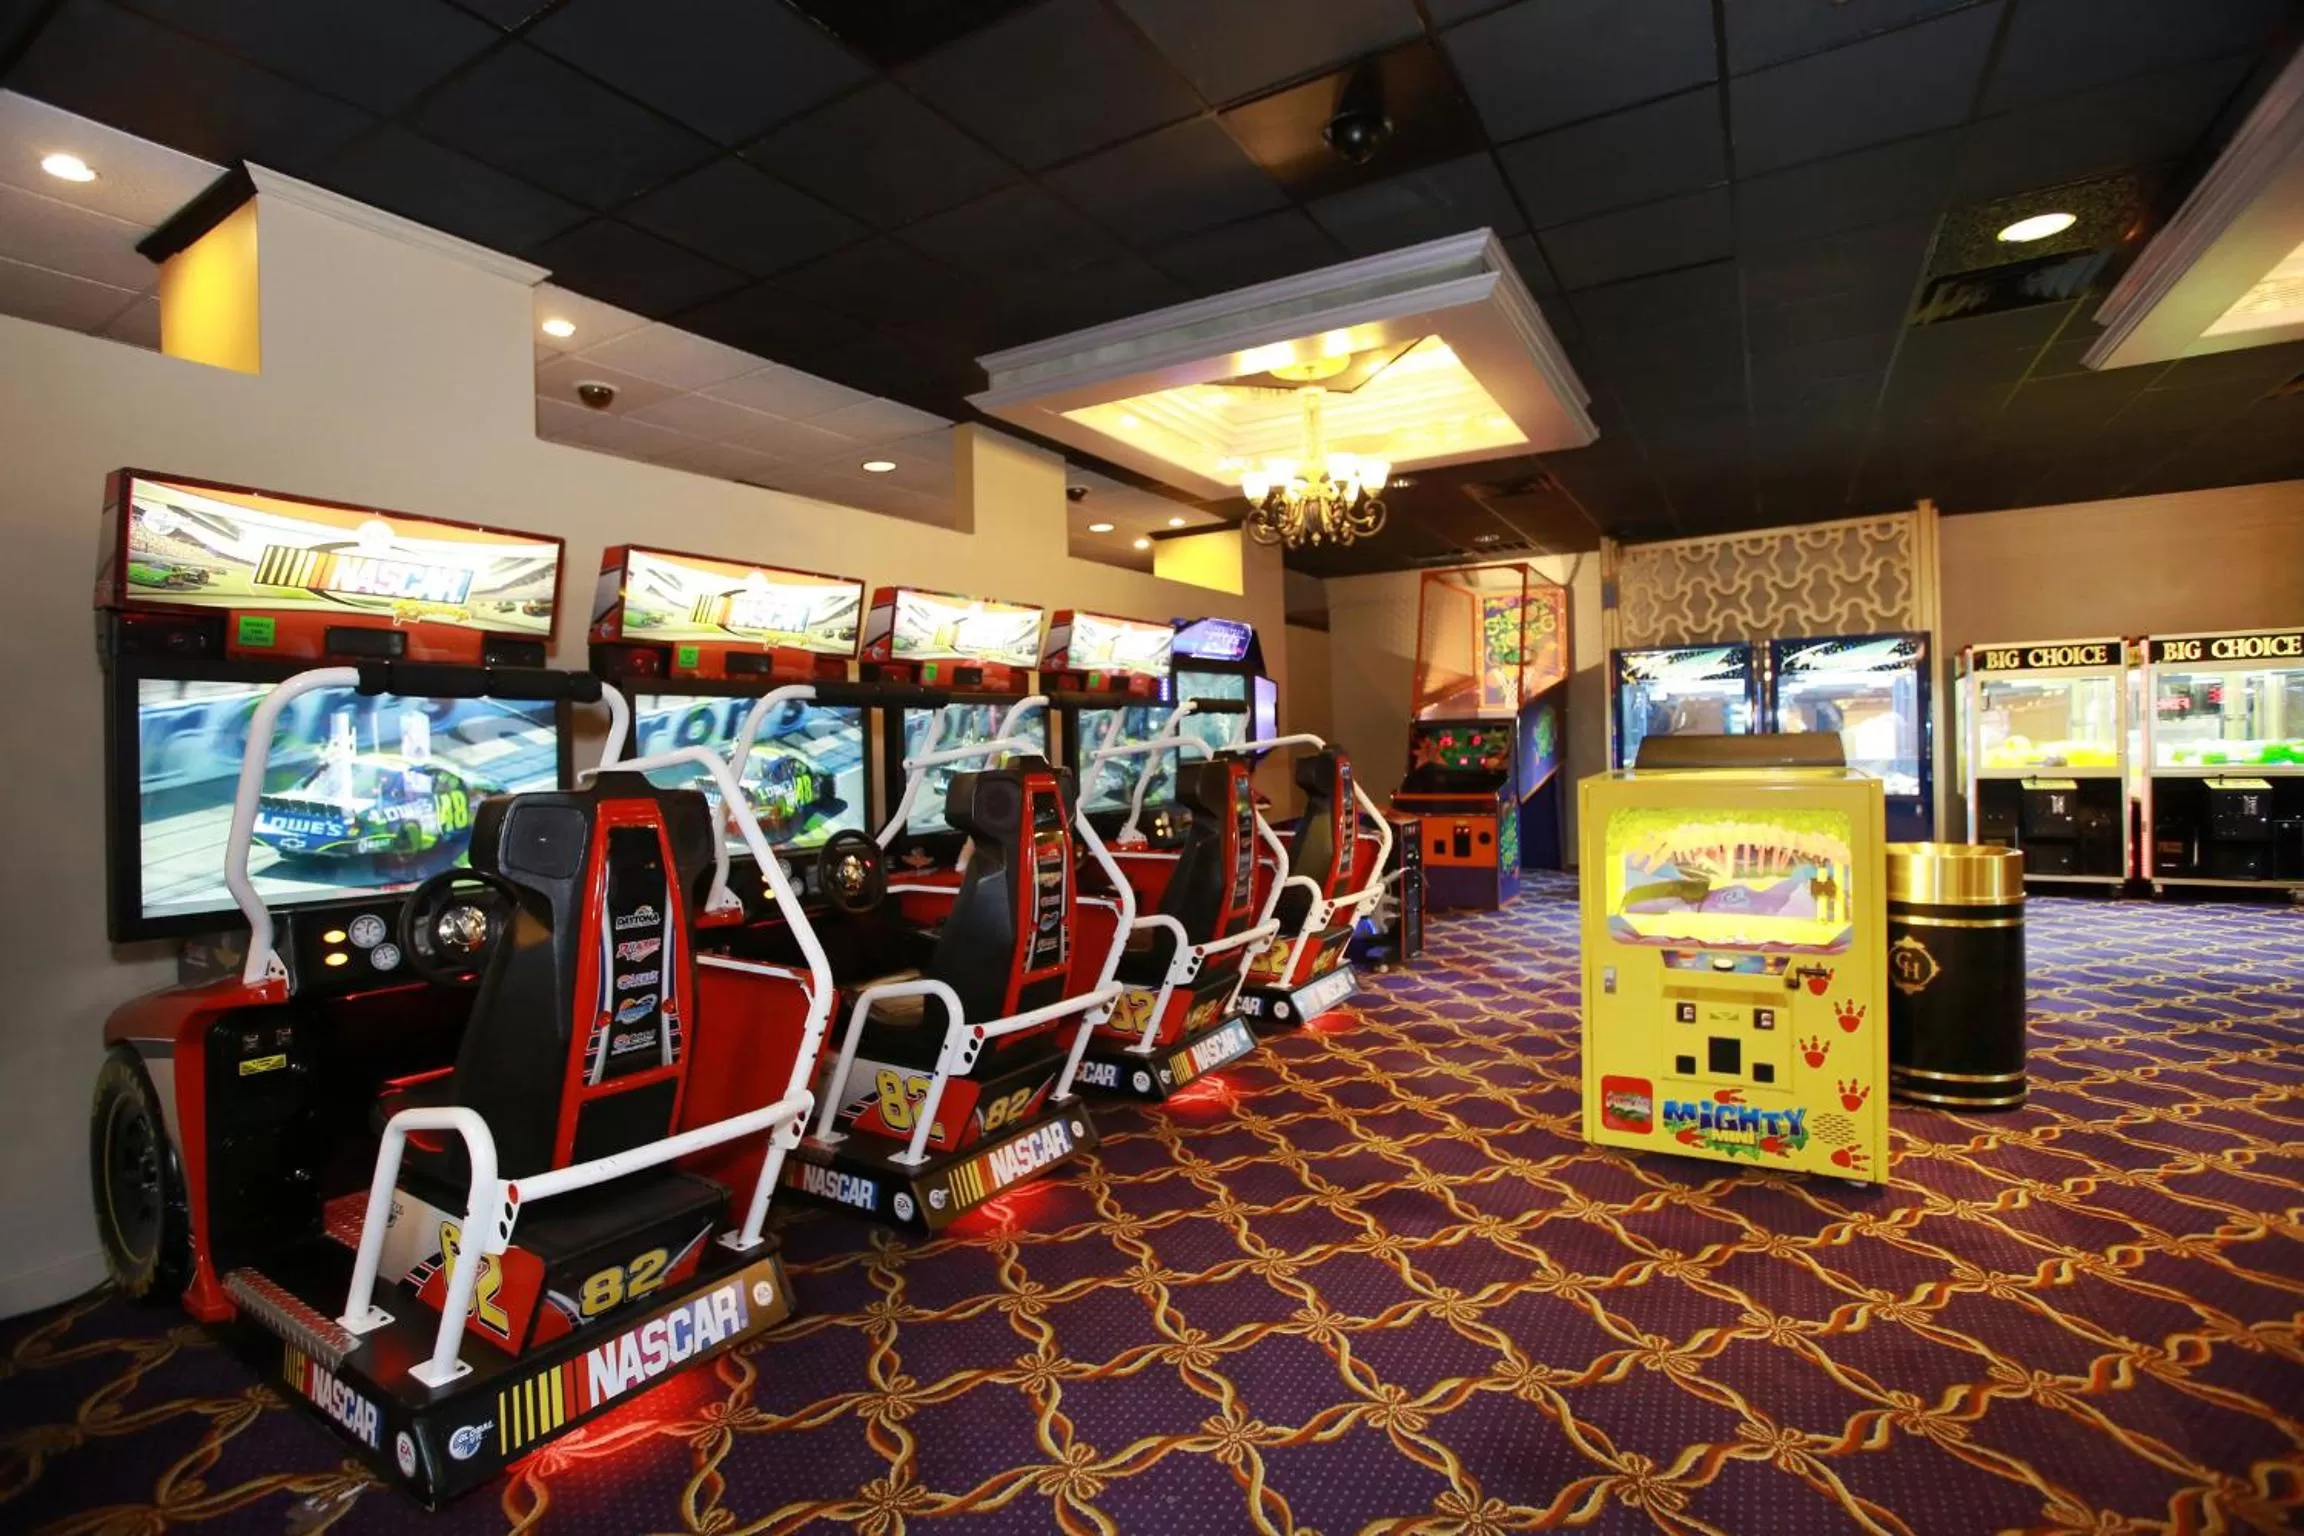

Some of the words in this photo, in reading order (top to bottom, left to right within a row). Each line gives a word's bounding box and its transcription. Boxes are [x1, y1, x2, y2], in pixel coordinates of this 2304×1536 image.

[329, 554, 466, 603] NASCAR
[1986, 650, 2020, 670] BIG
[2028, 644, 2108, 668] CHOICE
[2163, 640, 2202, 663] BIG
[2211, 635, 2303, 660] CHOICE
[254, 811, 345, 838] LOWE'S
[983, 1086, 1033, 1132] 82
[986, 1120, 1073, 1189] NASCAR
[1711, 1129, 1757, 1146] MINI
[801, 1163, 876, 1213] NASCAR
[578, 1246, 670, 1318] 82
[585, 1284, 742, 1409] NASCAR
[311, 1362, 380, 1450] NASCAR
